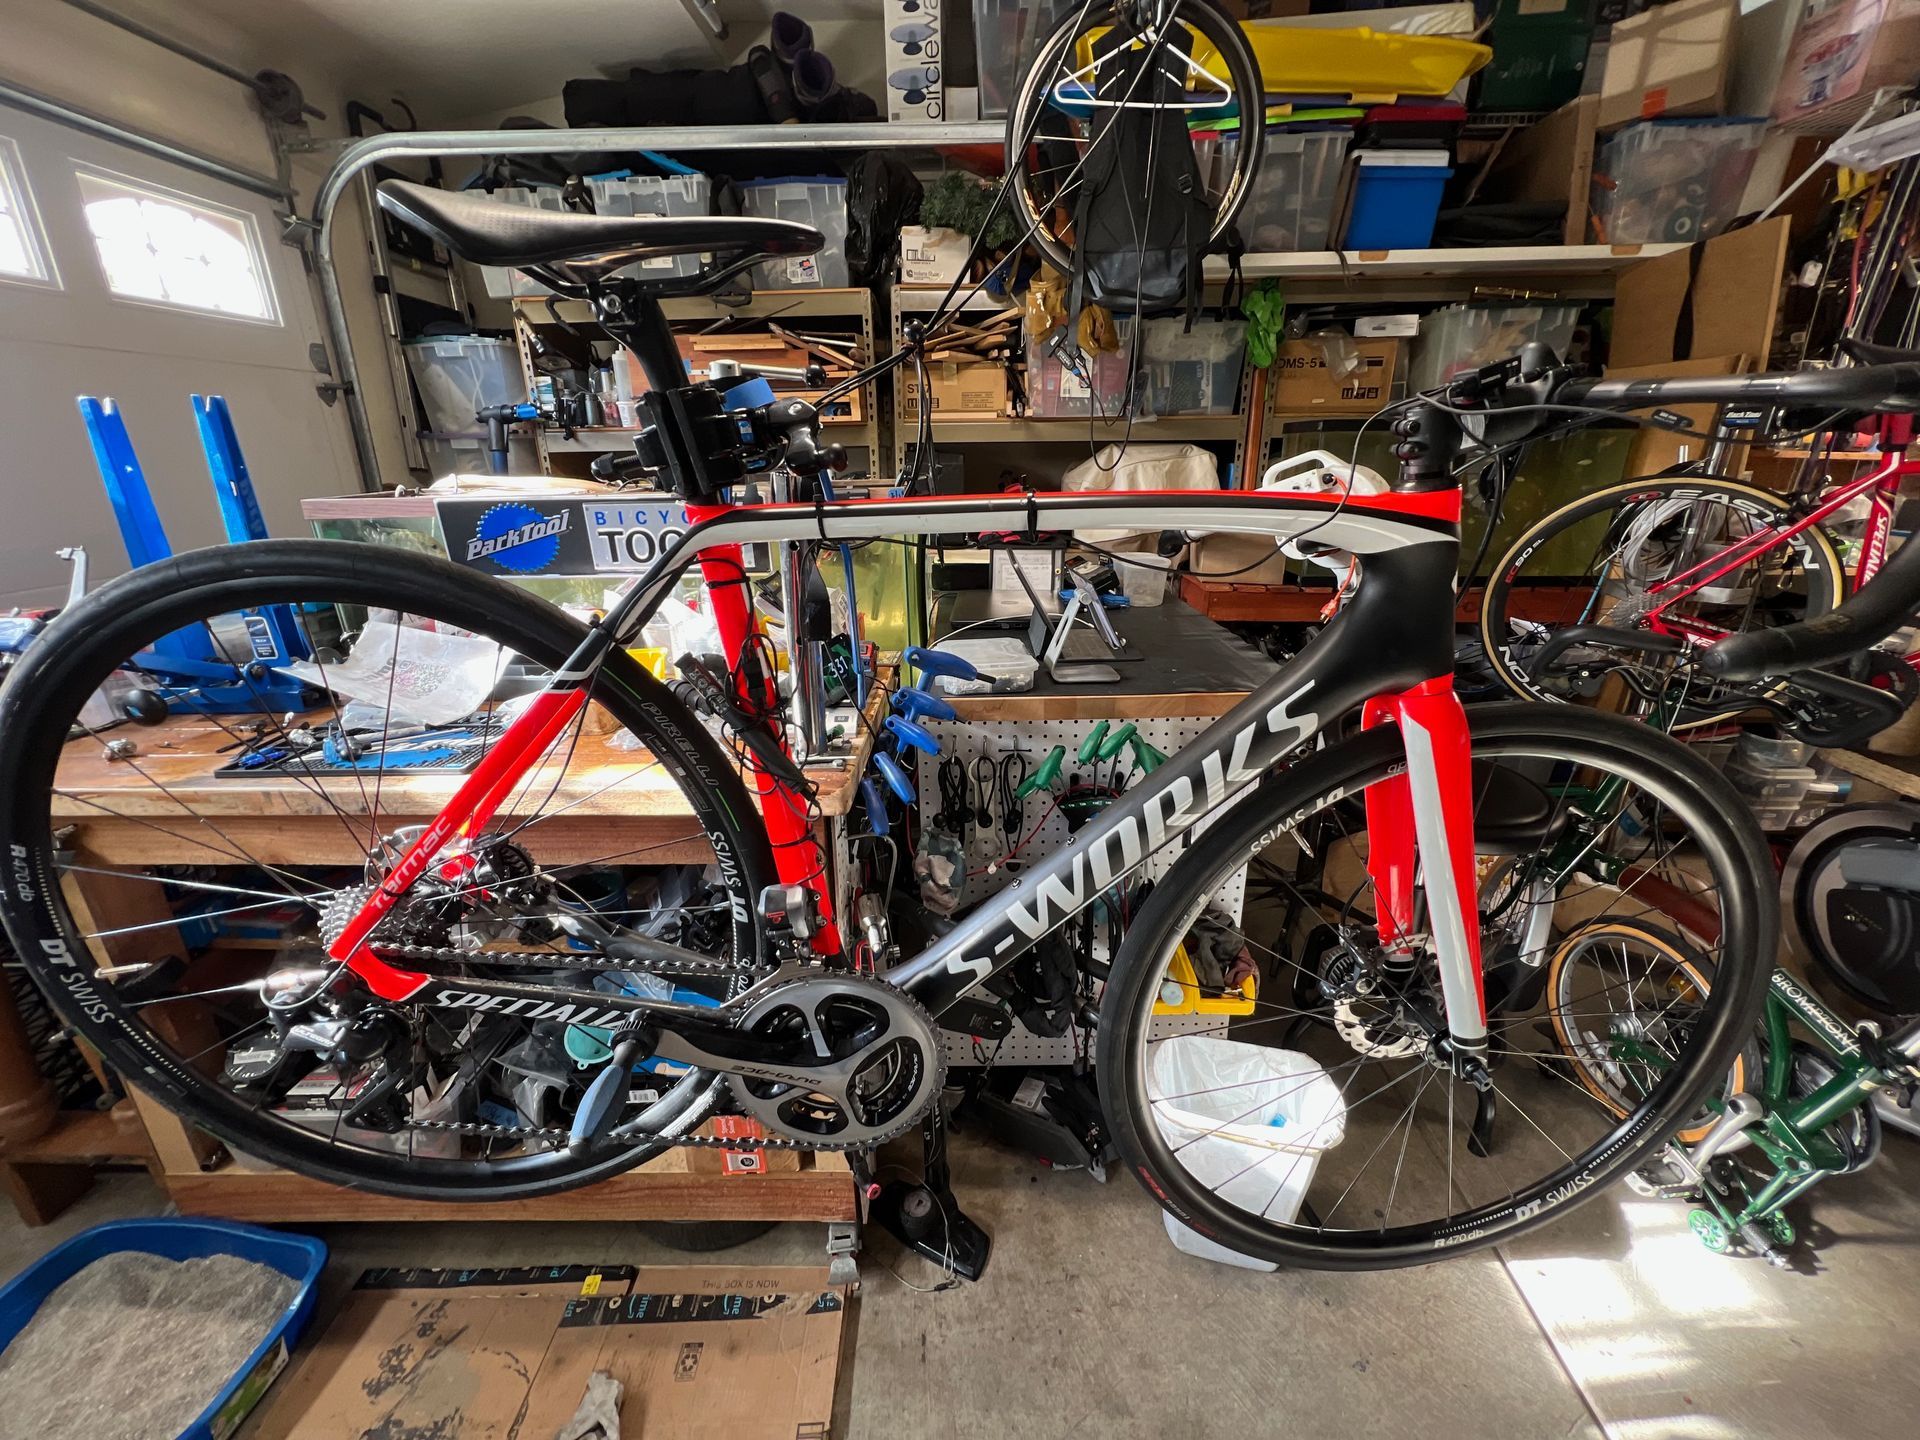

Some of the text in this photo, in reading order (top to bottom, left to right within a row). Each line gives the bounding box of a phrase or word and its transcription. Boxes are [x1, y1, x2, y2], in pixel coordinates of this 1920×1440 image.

[641, 702, 720, 787] PIRELLI
[946, 679, 1319, 999] S-WORKS
[1251, 787, 1344, 855] DT SWISS
[707, 831, 749, 924] DT SWISS
[39, 939, 115, 1023] DT SWISS
[1771, 973, 1857, 1047] BROMPTON
[731, 1064, 822, 1084] DURA-ACE
[1515, 1170, 1595, 1222] DT SWISS
[756, 1280, 780, 1289] NOW
